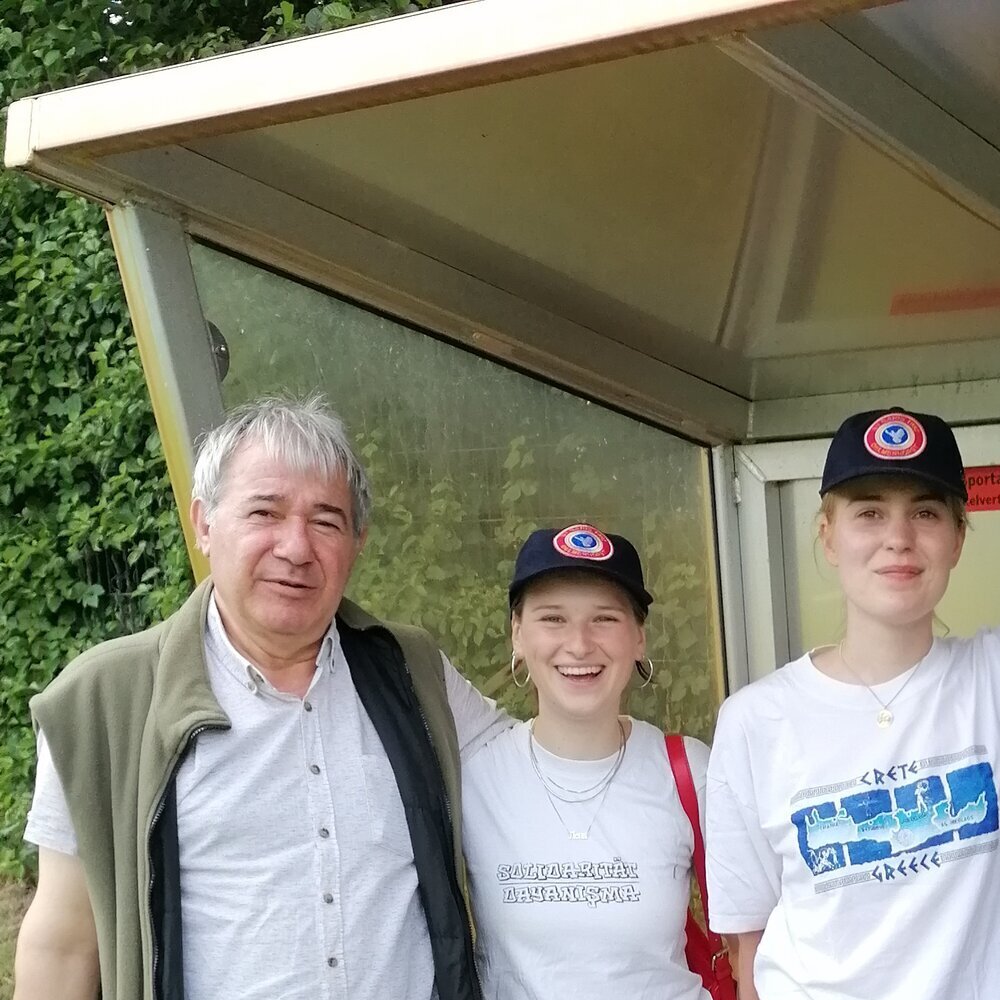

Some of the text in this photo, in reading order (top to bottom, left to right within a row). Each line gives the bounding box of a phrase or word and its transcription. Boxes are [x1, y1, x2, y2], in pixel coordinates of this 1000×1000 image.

[860, 760, 918, 785] CRETE
[497, 857, 639, 881] SOLIDARITÄT
[872, 851, 941, 882] GREECE
[503, 885, 641, 908] DAYANIŞMA
